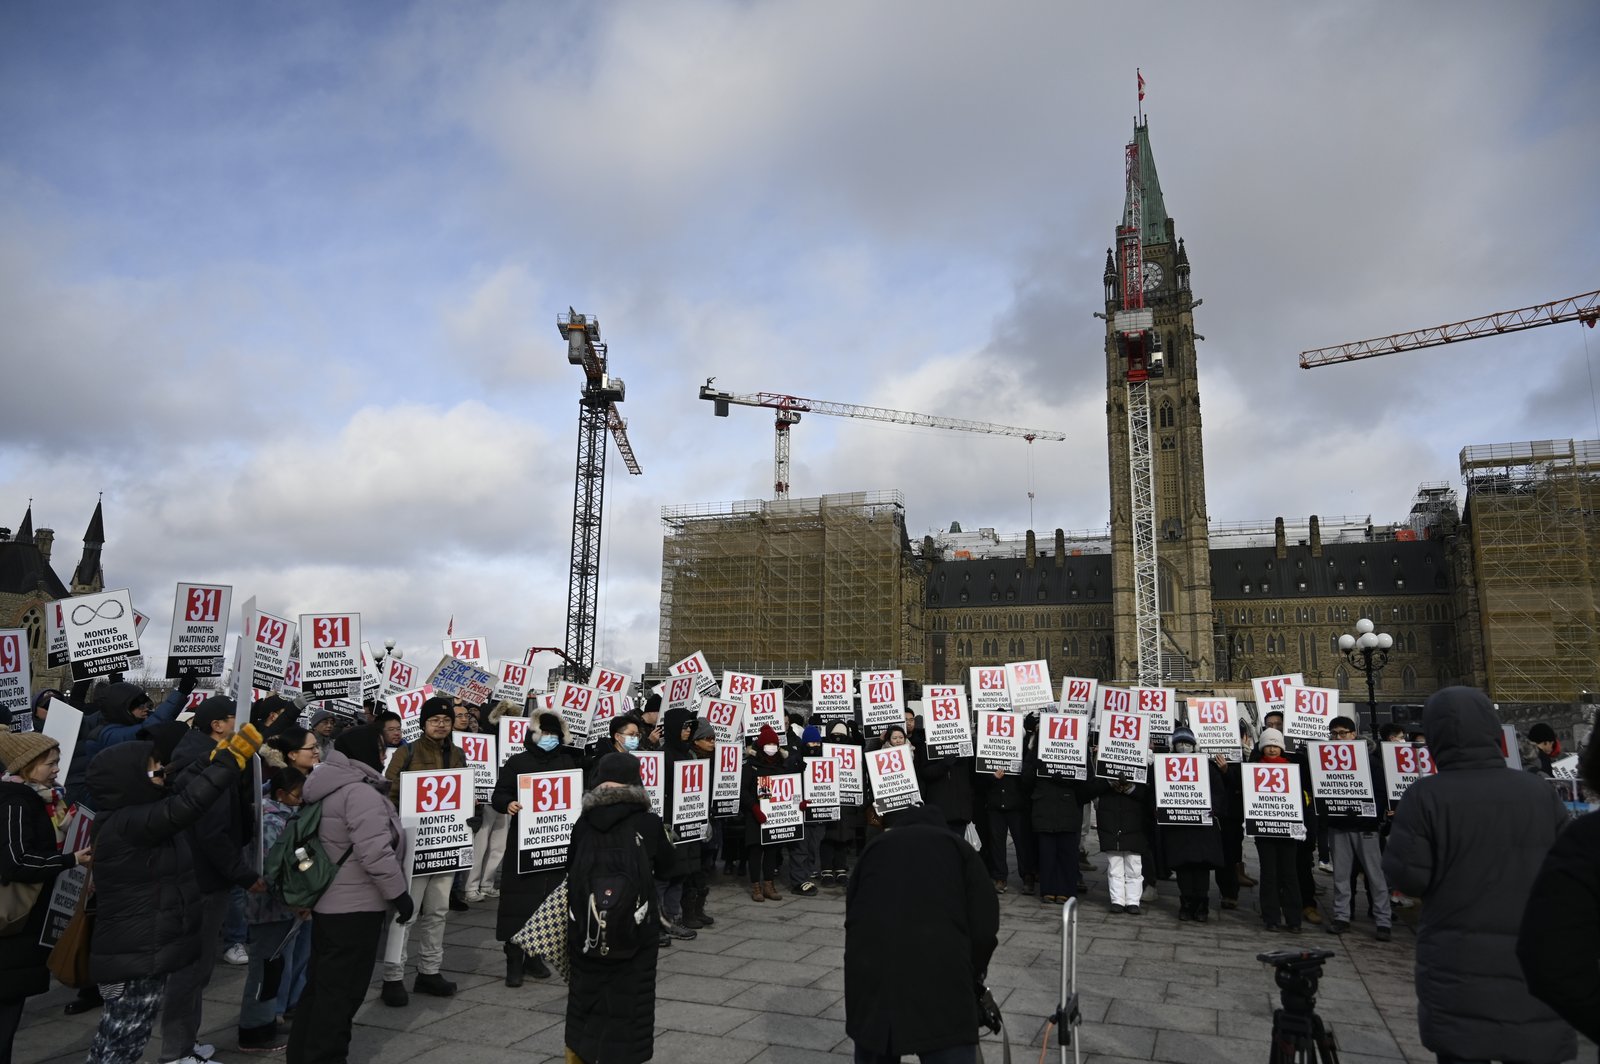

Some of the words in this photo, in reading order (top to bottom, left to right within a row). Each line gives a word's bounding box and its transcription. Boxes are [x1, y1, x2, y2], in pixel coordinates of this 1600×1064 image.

[190, 589, 215, 621] 31
[77, 637, 110, 649] WAITING
[112, 634, 128, 642] FOR
[84, 627, 118, 638] MONTHS
[179, 635, 205, 643] WAITING
[260, 617, 285, 647] 42
[318, 618, 345, 648] 31
[74, 649, 92, 658] IRCC
[93, 641, 134, 654] RESPONSE
[257, 645, 278, 656] MONTHS
[318, 651, 346, 659] MONTHS
[455, 641, 476, 659] 27
[99, 662, 127, 672] RESULTS
[257, 661, 283, 674] RESPONSE
[306, 670, 322, 678] IRCC
[323, 668, 357, 676] RESPONSE
[310, 660, 339, 669] WAITING
[391, 662, 409, 686] 25
[447, 660, 471, 674] STOP
[471, 670, 490, 684] THE
[506, 666, 523, 685] 19
[598, 672, 622, 691] 27
[823, 674, 843, 692] 38
[982, 670, 1003, 689] 34
[1017, 665, 1039, 684] 34
[672, 679, 689, 701] 68
[732, 676, 752, 694] 33
[871, 682, 893, 703] 40
[1070, 681, 1089, 701] 22
[400, 691, 423, 718] 22
[565, 687, 589, 711] 29
[753, 694, 773, 713] 30
[1107, 691, 1128, 711] 40
[1141, 690, 1163, 711] 33
[1298, 690, 1325, 715] 30
[562, 709, 583, 718] MONTHS
[710, 703, 732, 724] 68
[936, 699, 957, 720] 53
[1201, 702, 1225, 723] 46
[990, 716, 1010, 736] 15
[1053, 718, 1074, 739] 71
[1113, 716, 1137, 740] 53
[1291, 722, 1316, 730] WAITING
[465, 738, 484, 761] 37
[1111, 740, 1135, 748] MONTHS
[723, 747, 736, 771] 19
[878, 751, 902, 774] 28
[1115, 755, 1144, 763] RESPONSE
[1324, 745, 1353, 770] 39
[641, 757, 656, 785] 39
[685, 765, 700, 792] 11
[815, 761, 832, 782] 51
[882, 773, 904, 782] MONTHS
[1168, 758, 1195, 781] 34
[772, 779, 791, 801] 40
[878, 781, 899, 789] WAITING
[889, 784, 914, 793] RESPONSE
[1258, 769, 1286, 792] 23
[421, 776, 456, 812] 32
[537, 778, 567, 811] 31
[420, 815, 455, 824] MONTHS
[448, 824, 463, 833] FOR
[536, 814, 567, 824] MONTHS
[775, 816, 799, 824] RESPONSE
[529, 825, 559, 835] WAITING
[425, 834, 468, 846] RESPONSE
[524, 838, 540, 846] IRCC
[416, 862, 426, 870] NO
[427, 858, 457, 868] RESULTS
[424, 850, 459, 860] TIMELINES
